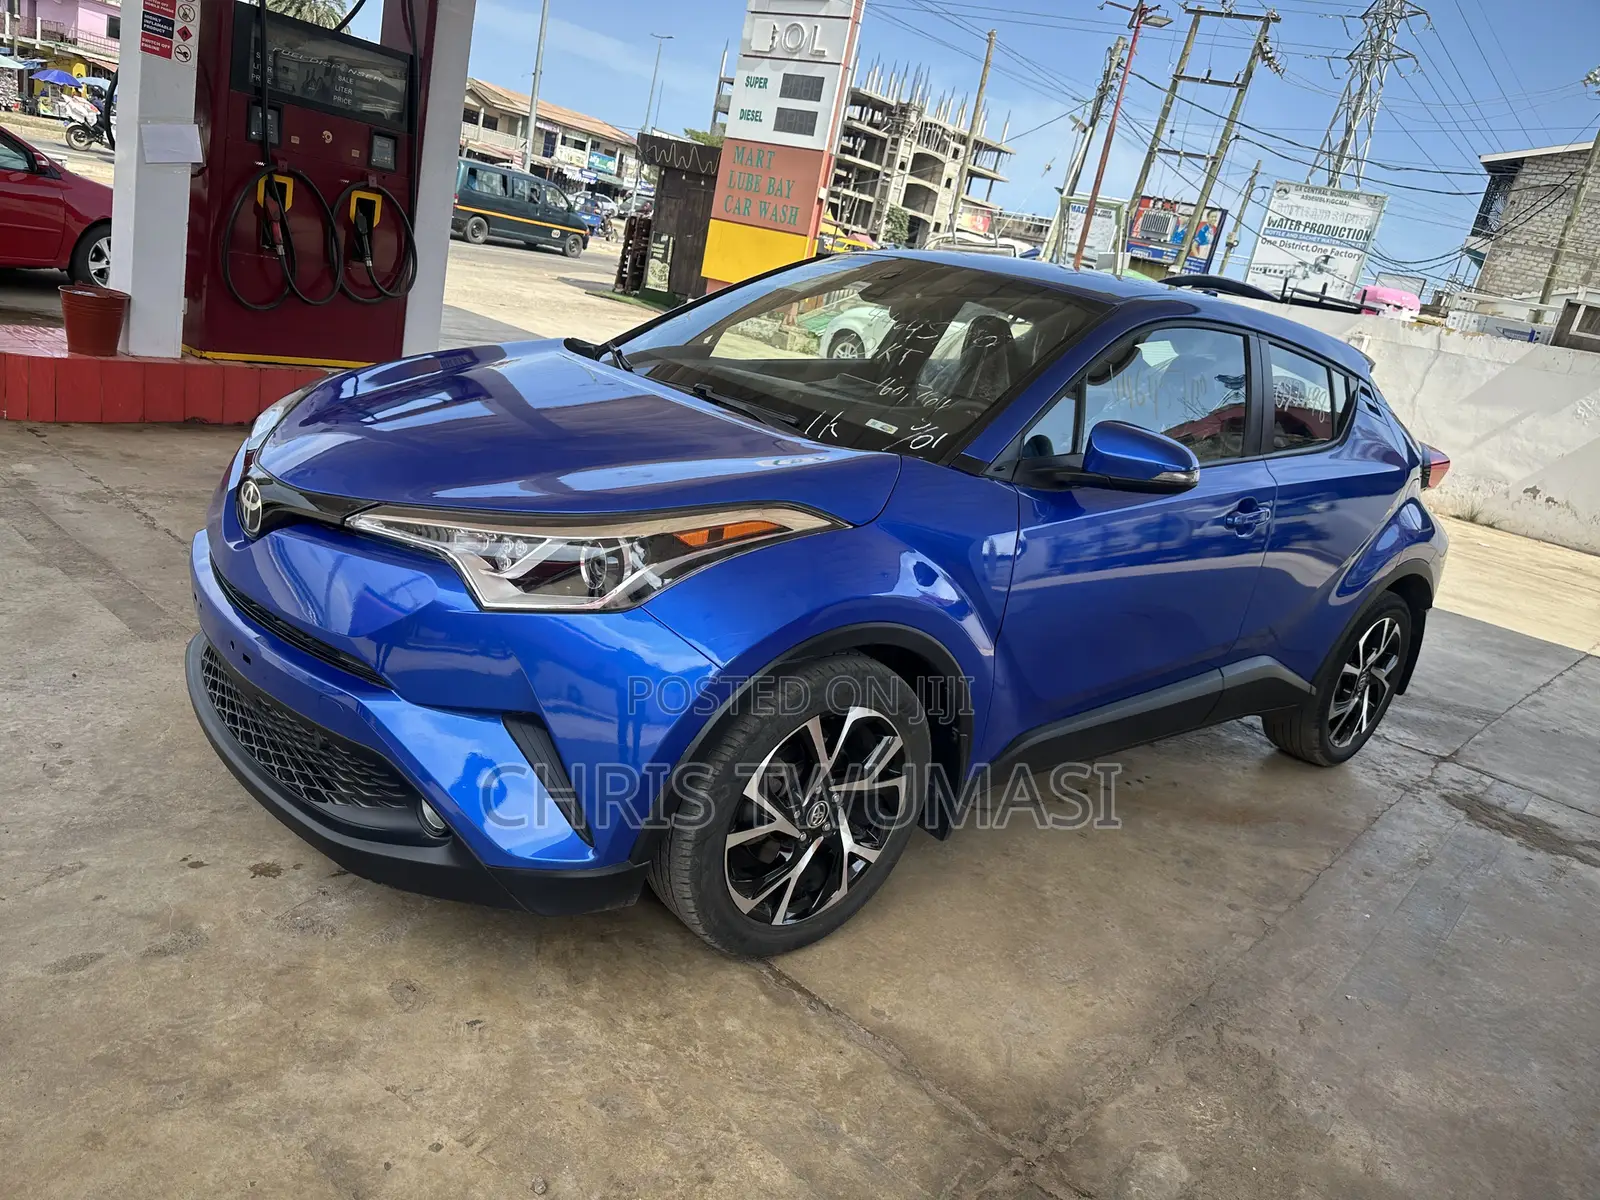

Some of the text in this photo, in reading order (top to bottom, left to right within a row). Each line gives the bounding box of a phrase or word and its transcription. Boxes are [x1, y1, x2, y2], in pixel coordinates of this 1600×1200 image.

[143, 23, 166, 33] PRODUCT
[337, 75, 354, 85] SALE
[744, 75, 769, 89] SUPER
[334, 84, 353, 95] LITER
[333, 95, 353, 106] PRICE
[739, 108, 763, 122] DIESEL
[733, 145, 776, 170] MART
[727, 170, 796, 199] LUBE BAY
[723, 195, 800, 226] CAR WASH
[1267, 216, 1372, 241] WATER PRODUCTION
[1260, 237, 1278, 246] One
[1330, 248, 1363, 261] Factory
